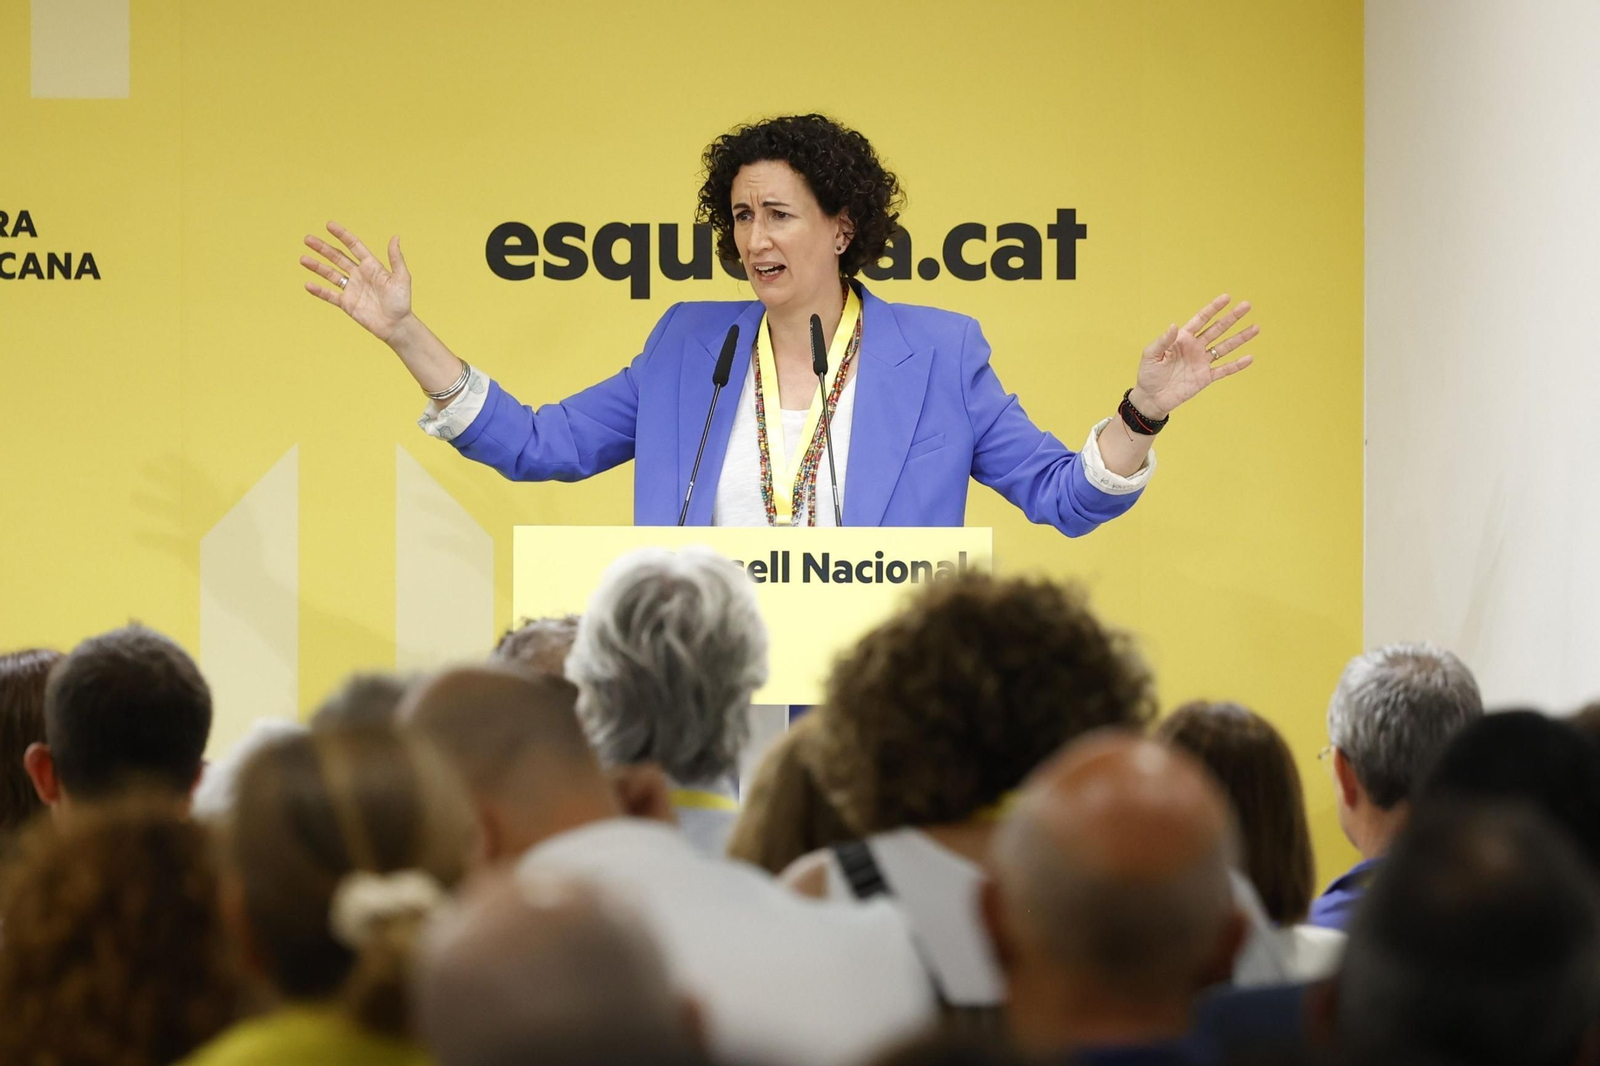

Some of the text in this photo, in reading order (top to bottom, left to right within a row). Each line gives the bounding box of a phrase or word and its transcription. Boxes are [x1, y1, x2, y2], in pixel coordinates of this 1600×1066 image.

[0, 252, 101, 280] CANA
[485, 208, 1087, 300] esqua.cat
[802, 550, 967, 584] Nacional
